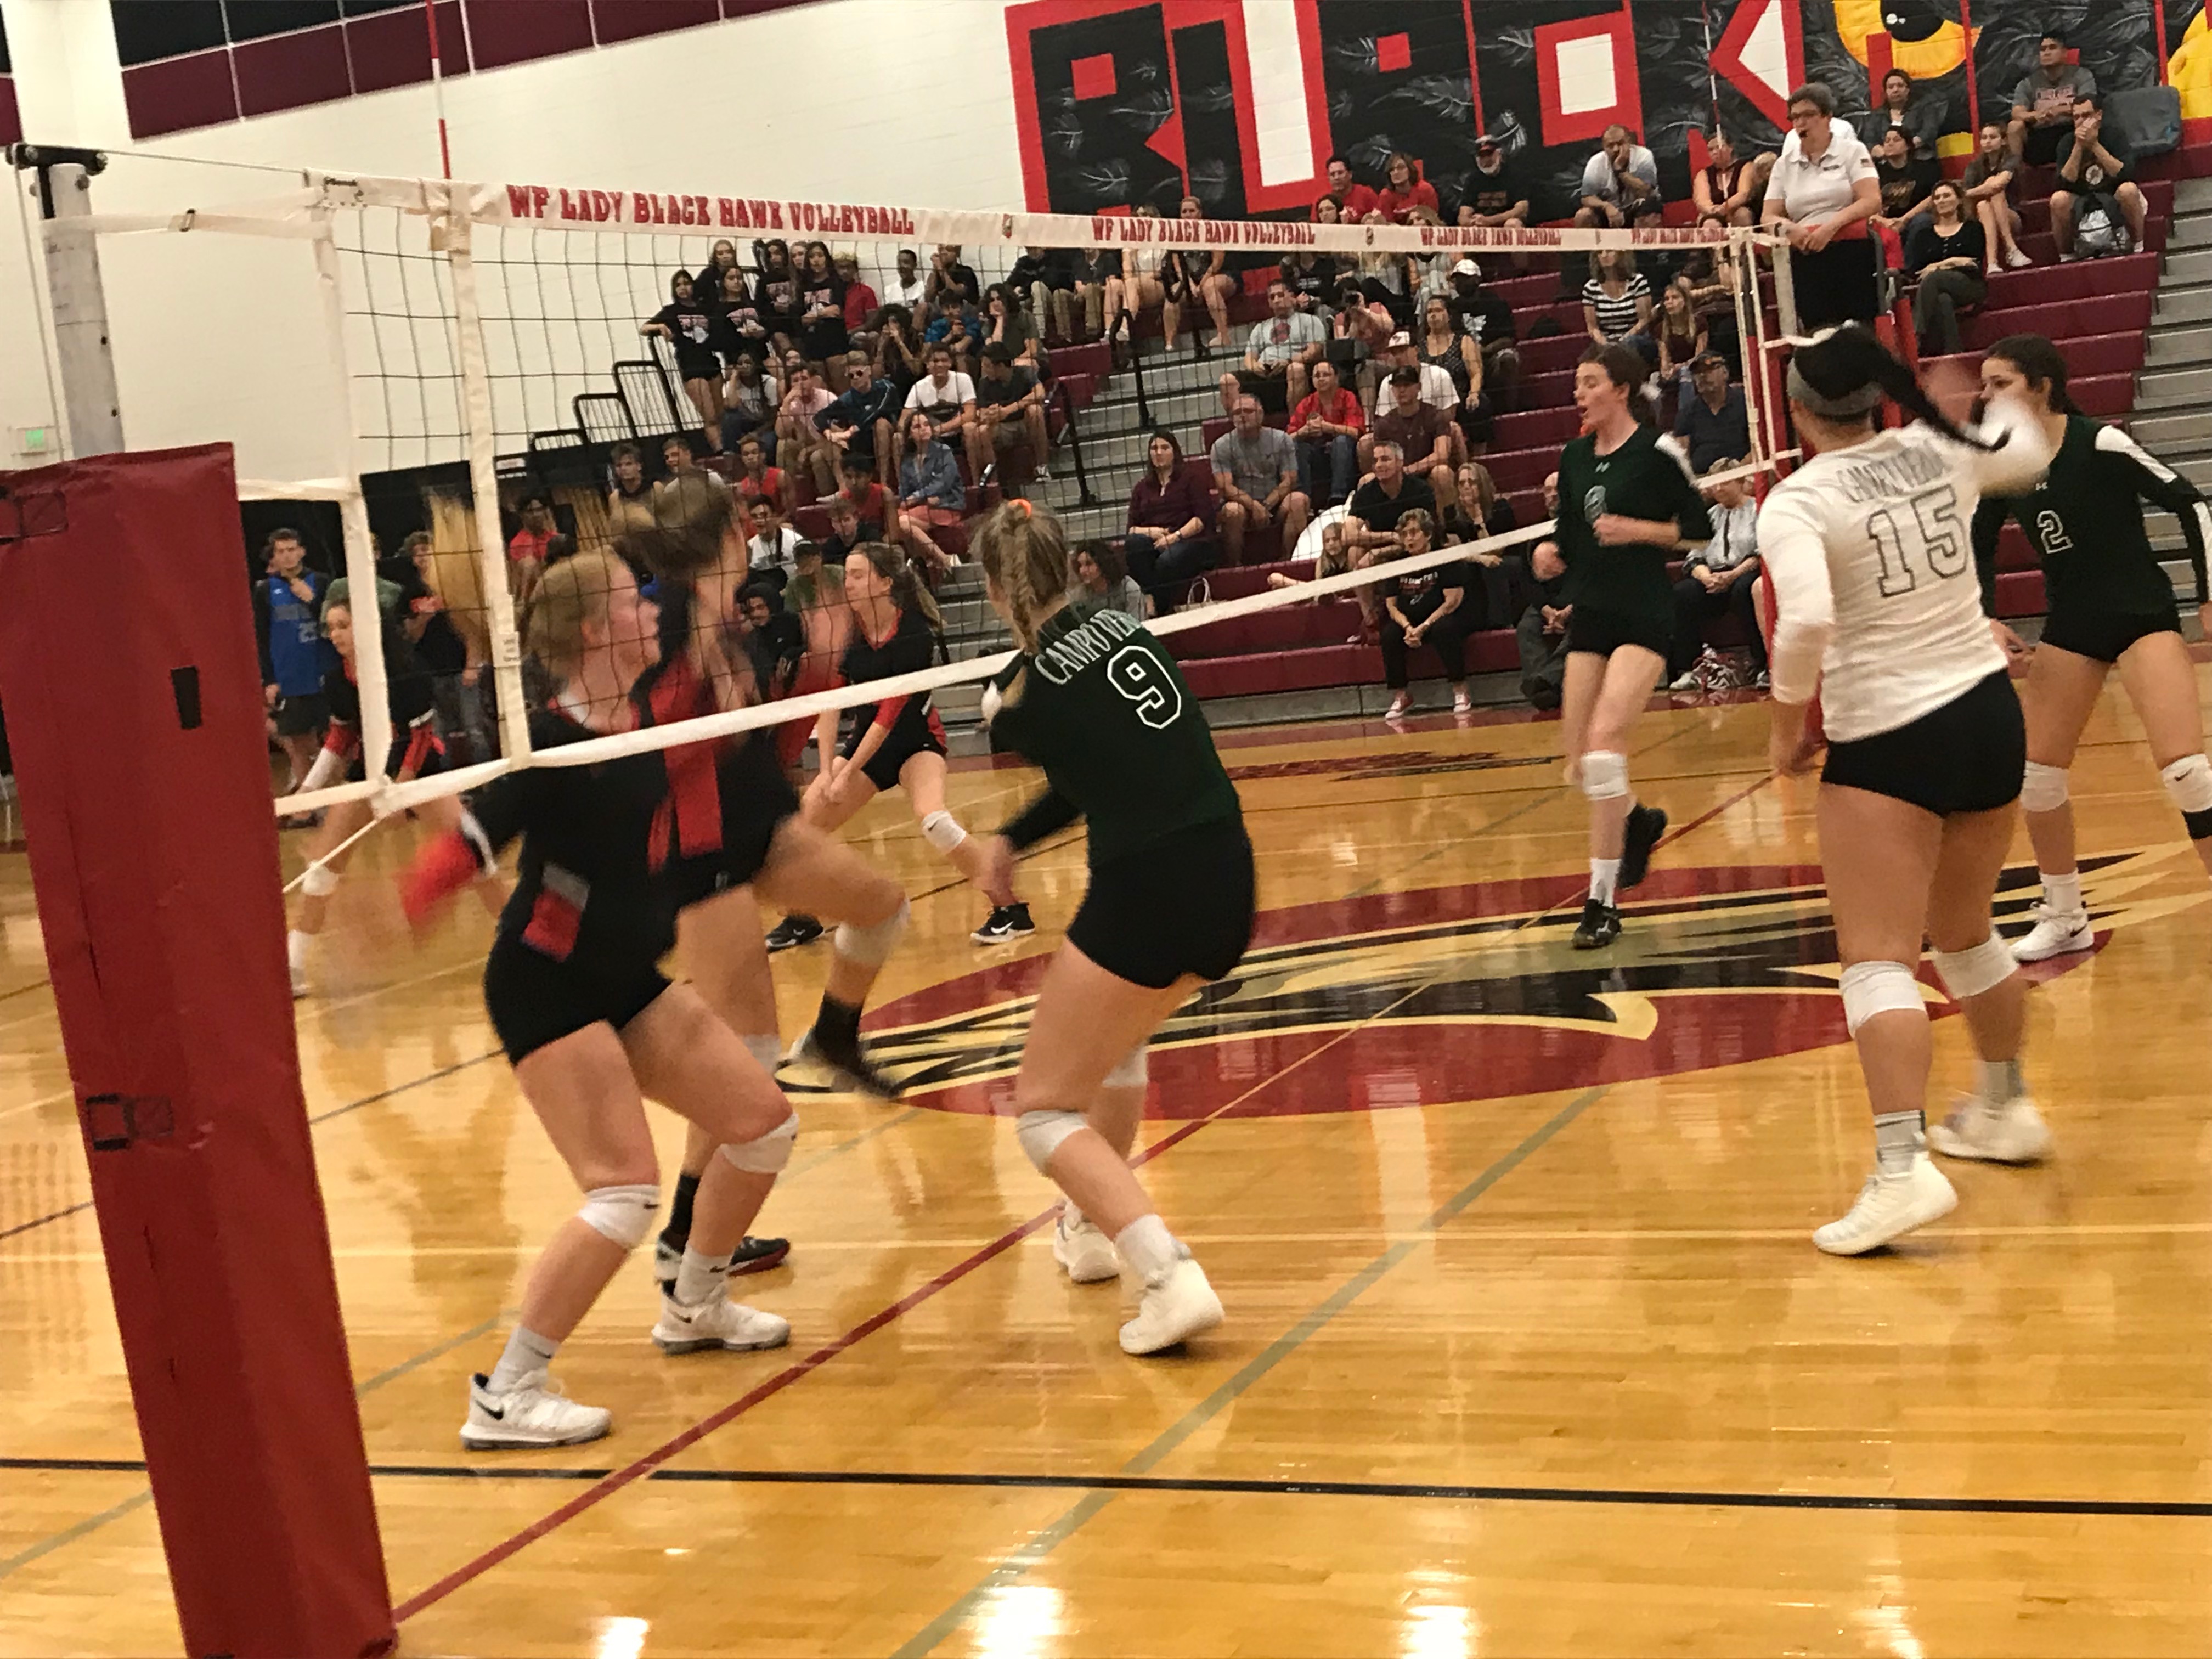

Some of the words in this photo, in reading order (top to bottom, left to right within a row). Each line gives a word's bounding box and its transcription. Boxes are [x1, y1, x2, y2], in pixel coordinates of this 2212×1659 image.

[506, 184, 549, 218] WF
[560, 187, 623, 222] LADY
[633, 191, 711, 227] BLACK
[718, 197, 783, 230] HAWK
[788, 201, 915, 235] VOLLEYBALL
[1091, 217, 1115, 241] WF
[1120, 218, 1153, 242] LADY
[1158, 219, 1200, 243] BLACK
[1204, 220, 1239, 244] HAWK
[1243, 221, 1316, 245] VOLLEYBALL
[1866, 483, 1968, 598] 15
[2036, 510, 2074, 554] 2
[1034, 623, 1111, 685] CAMPO
[1106, 645, 1182, 730] 9
